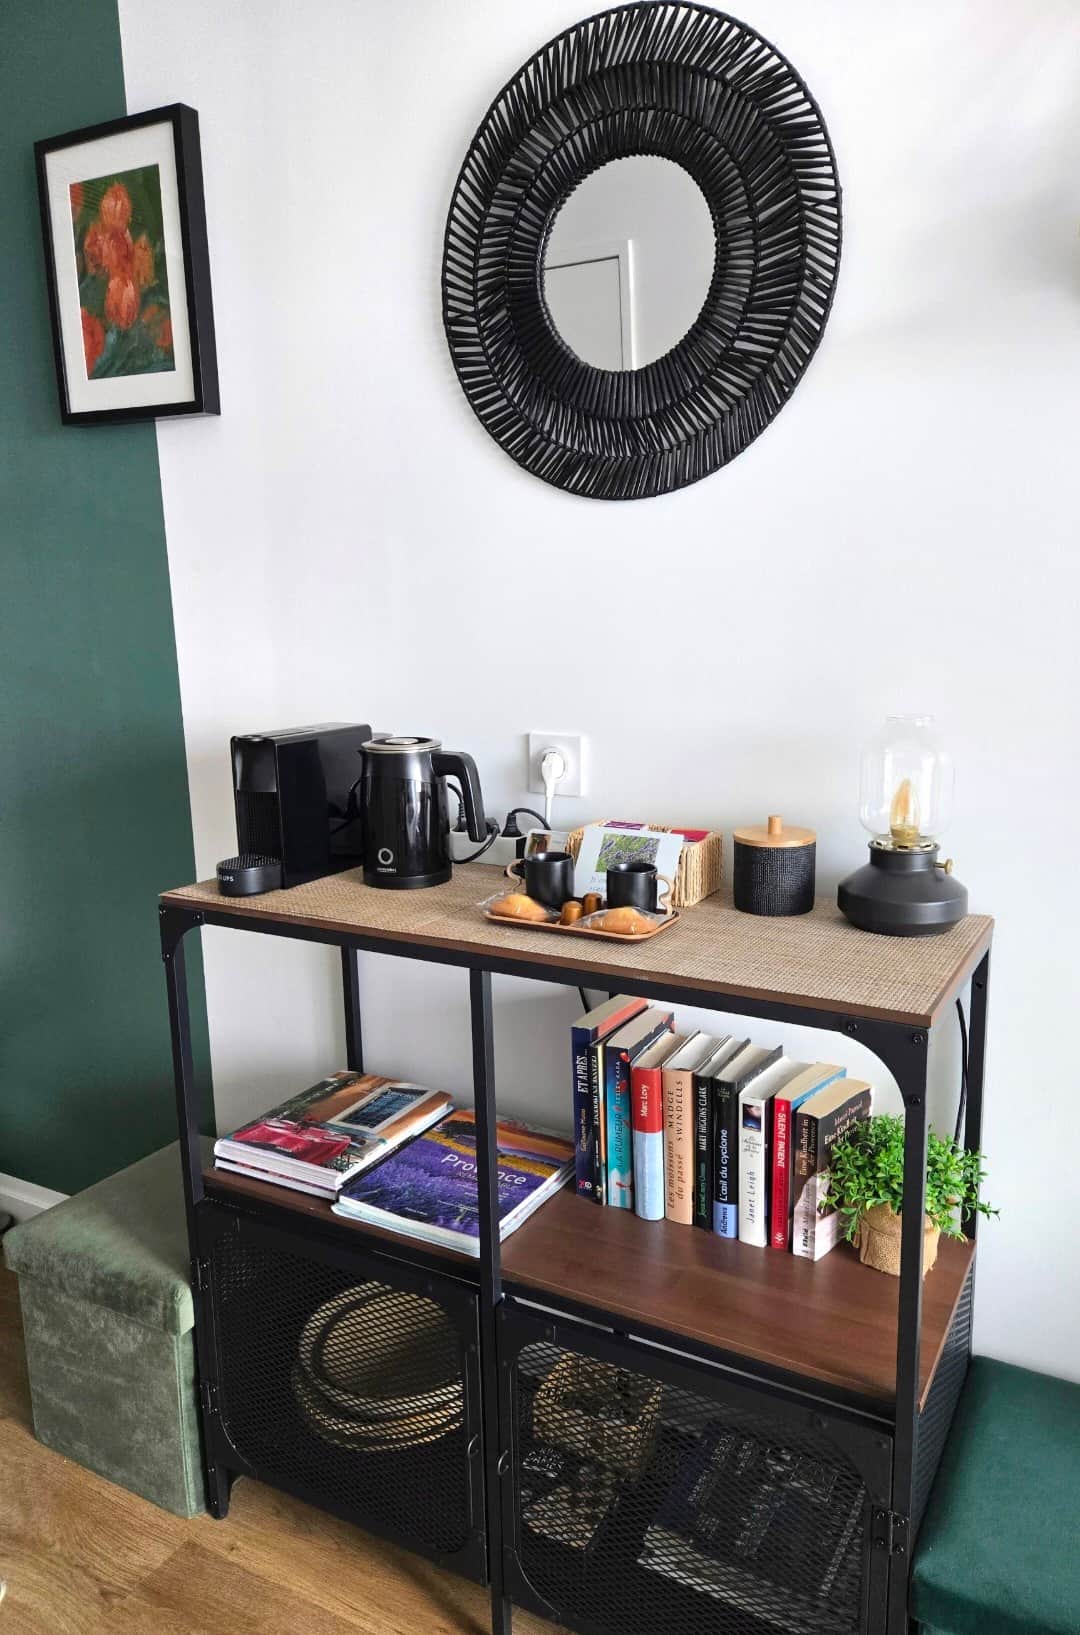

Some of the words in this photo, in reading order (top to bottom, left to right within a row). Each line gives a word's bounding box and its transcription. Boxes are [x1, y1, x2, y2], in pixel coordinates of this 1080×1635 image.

[577, 1080, 589, 1094] ET
[640, 1084, 649, 1100] Levy
[699, 1087, 707, 1106] CLARK
[640, 1101, 648, 1117] Marc
[667, 1091, 675, 1128] MADGE
[675, 1080, 683, 1142] SWINDELLS
[699, 1108, 707, 1133] HIGGINS
[614, 1113, 625, 1152] RUMEUR
[777, 1113, 786, 1139] SILENT
[719, 1129, 729, 1163] cyclone
[777, 1141, 786, 1168] PATIENT
[799, 1128, 808, 1159] Kindheit
[667, 1141, 675, 1188] moissons
[676, 1154, 686, 1183] passé
[719, 1165, 728, 1181] du
[675, 1187, 684, 1200] du
[746, 1171, 756, 1195] Leigh
[667, 1193, 675, 1209] Les
[746, 1196, 756, 1223] Janet
